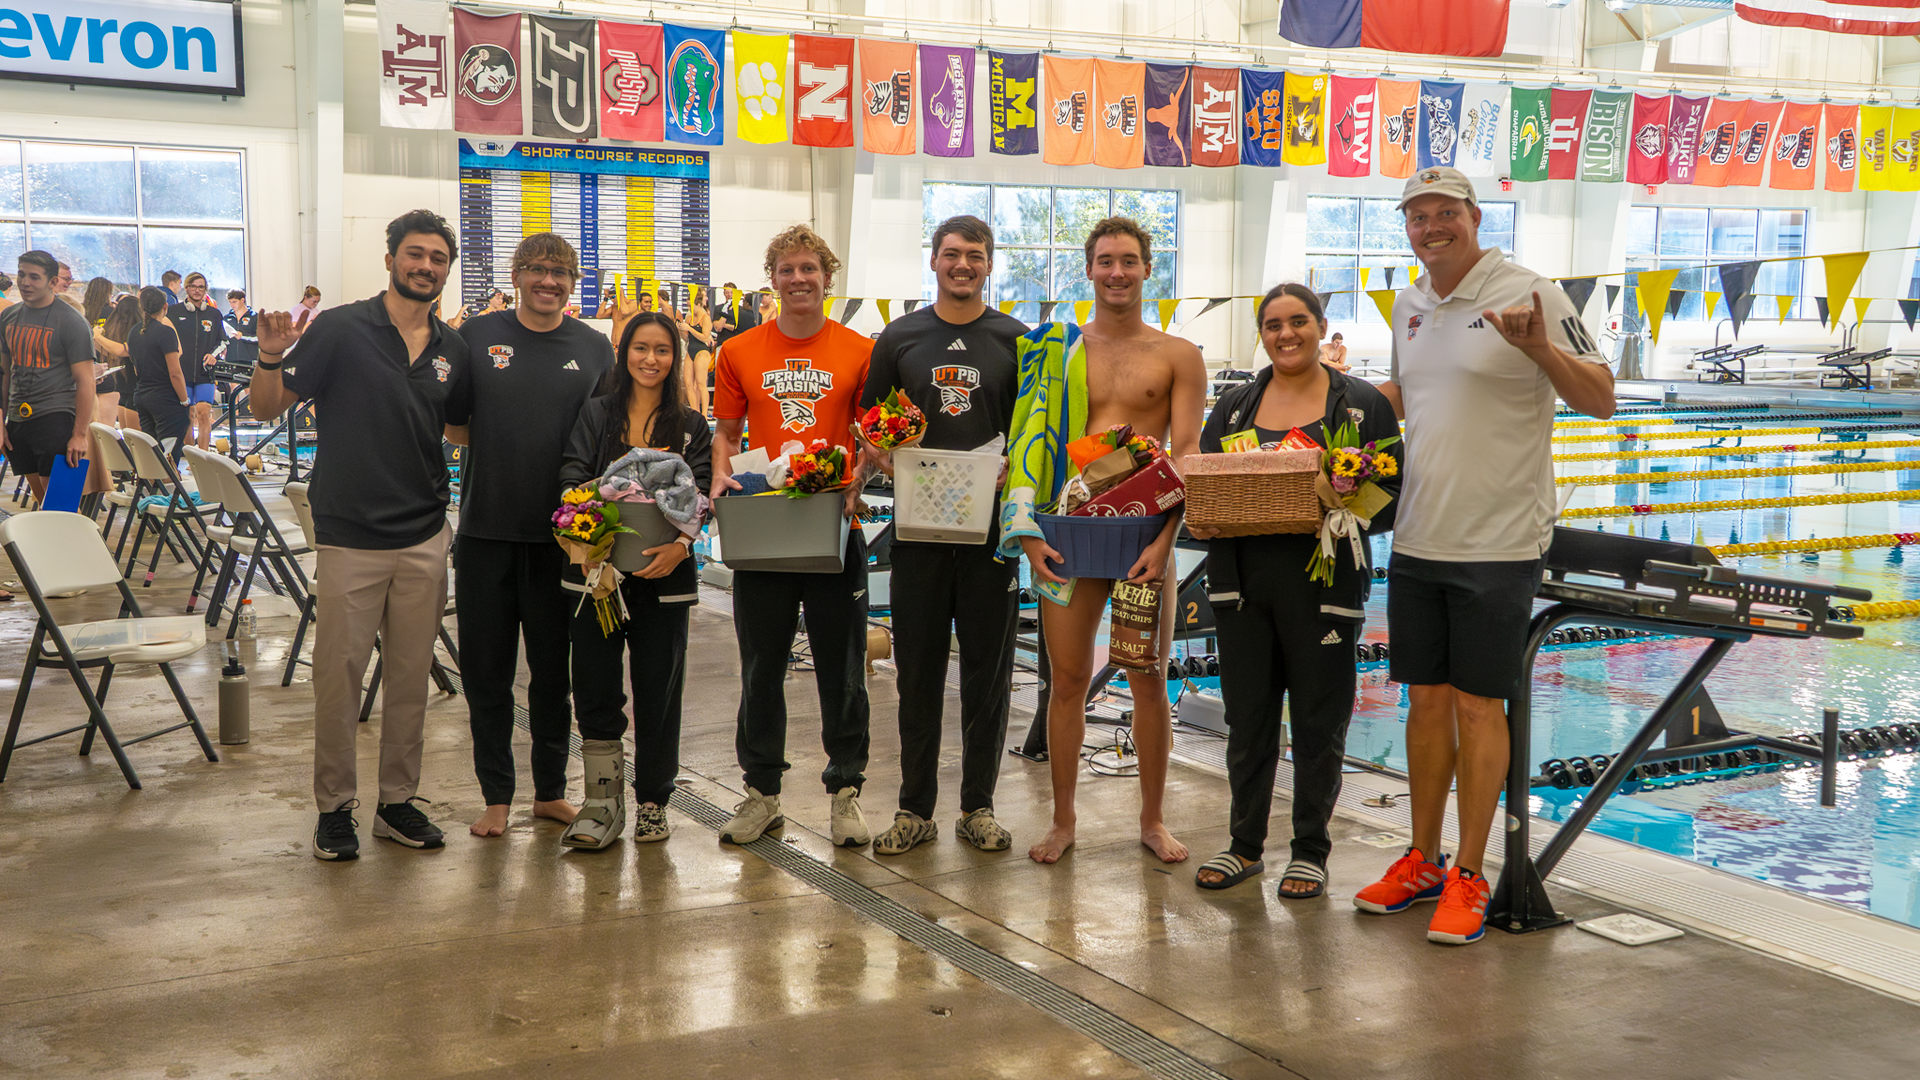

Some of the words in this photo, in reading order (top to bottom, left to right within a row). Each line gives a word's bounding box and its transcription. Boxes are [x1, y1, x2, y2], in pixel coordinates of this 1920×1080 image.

[799, 61, 848, 123] N
[896, 73, 911, 125] UTPB
[992, 56, 1004, 149] MICHIGAN
[1005, 77, 1036, 129] M
[1075, 92, 1086, 132] UTPB
[1126, 96, 1137, 135] UTPB
[1261, 89, 1281, 150] SMU
[1353, 91, 1373, 164] UIW
[1472, 99, 1493, 161] Cougars
[1537, 100, 1550, 135] MIDLAND
[1484, 103, 1500, 161] BARTON
[1583, 96, 1621, 177] BISON
[1677, 105, 1702, 178] SALUKIS
[1715, 124, 1734, 162] UTPB
[1747, 123, 1768, 162] UTPB
[1796, 128, 1813, 167] UTPB
[1842, 129, 1855, 168] UTPB
[1874, 128, 1886, 172] VALPO
[521, 146, 571, 159] SHORT
[575, 149, 634, 162] COURSE
[638, 152, 704, 166] RECORDS
[1537, 136, 1550, 171] COLLEGE
[490, 346, 512, 354] UTPB
[788, 360, 809, 371] UT
[765, 370, 830, 386] PERMIAN
[775, 380, 820, 394] BASIN
[935, 367, 977, 384] UTPB
[452, 447, 461, 460] 6
[1159, 493, 1186, 511] FANSVILLE
[1130, 613, 1153, 624] CHIPS
[1186, 601, 1198, 624] 2
[1121, 641, 1147, 655] SALT
[1691, 705, 1700, 736] 1
